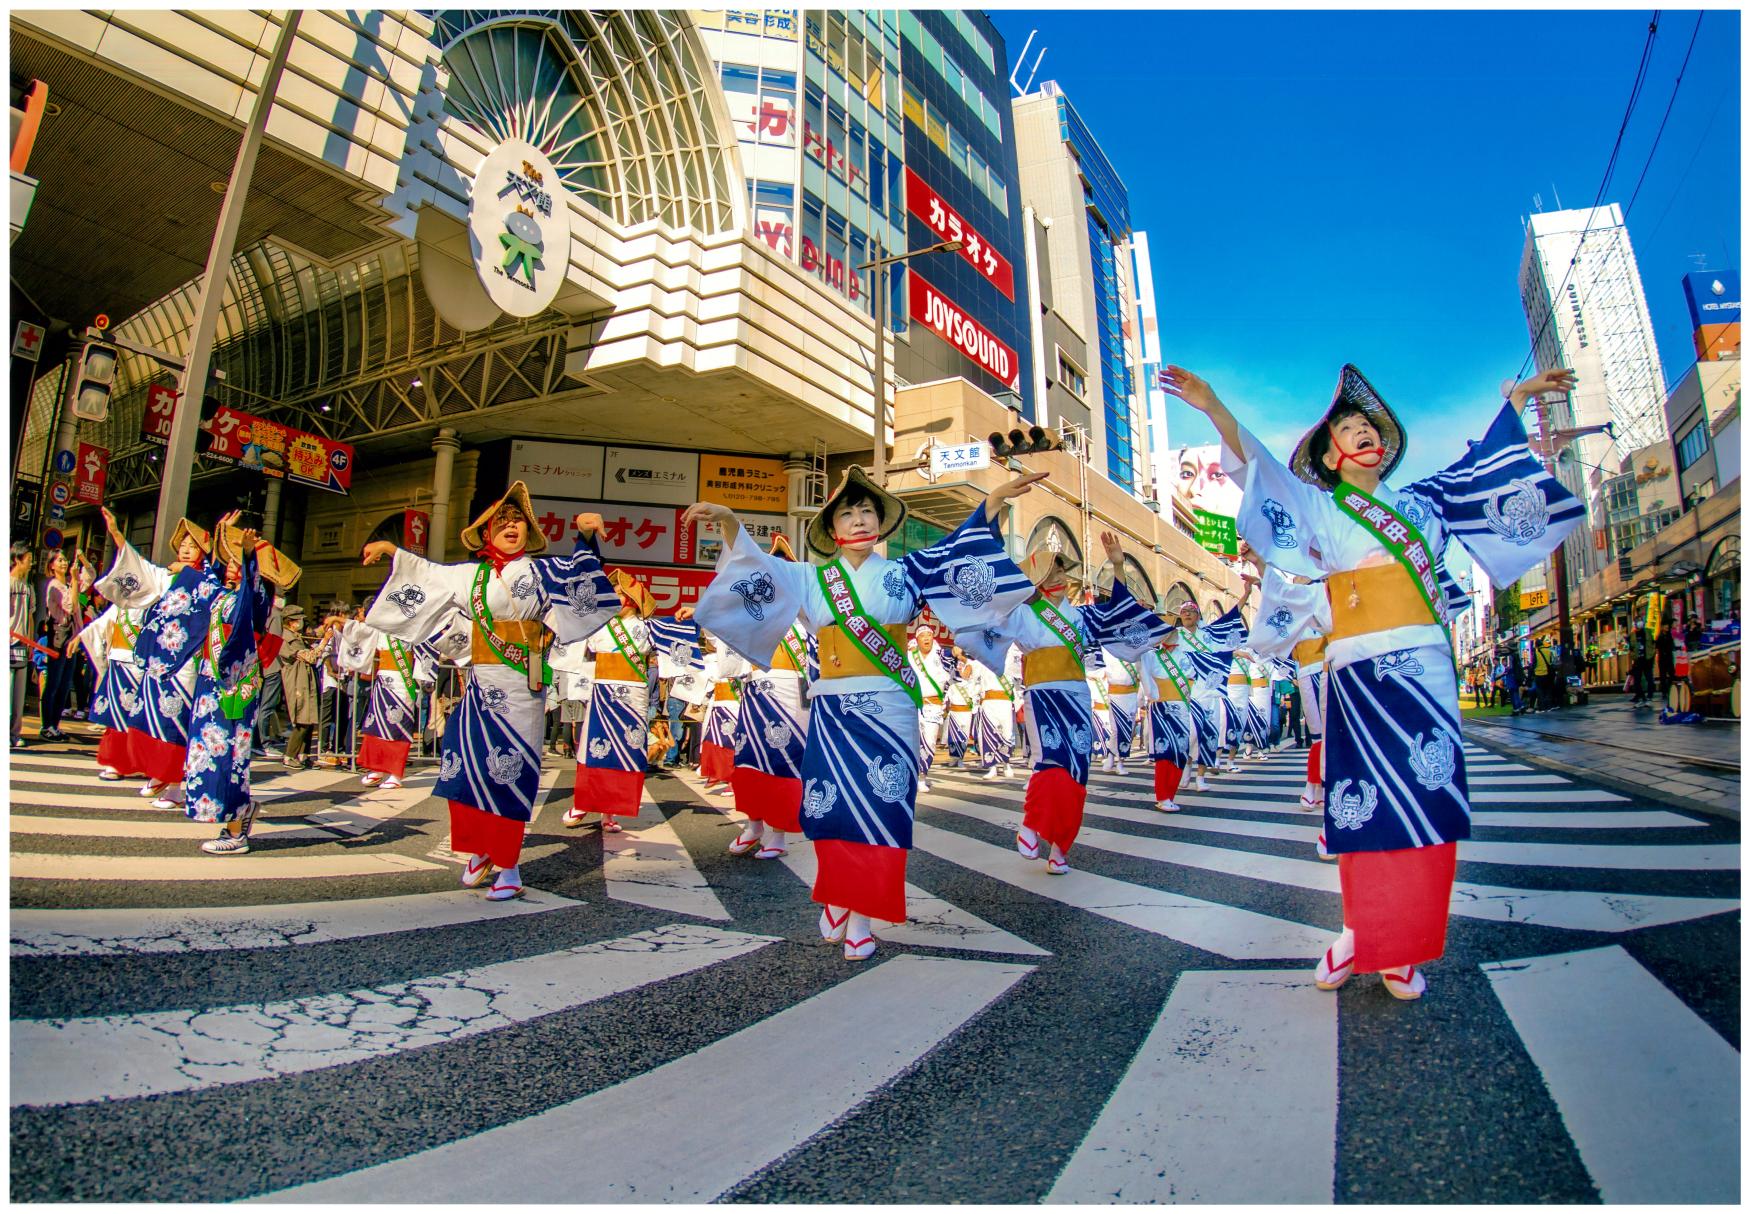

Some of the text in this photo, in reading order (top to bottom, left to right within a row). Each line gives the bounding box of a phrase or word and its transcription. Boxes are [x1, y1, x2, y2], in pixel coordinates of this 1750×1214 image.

[521, 159, 544, 182] The
[497, 170, 552, 216] 天文館
[929, 198, 998, 276] カラオケ
[493, 265, 504, 277] The
[924, 290, 1009, 379] JOYSOUND
[294, 448, 324, 464] 持込み
[332, 454, 347, 467] 4F
[940, 447, 980, 462] 天文館
[301, 465, 314, 475] OK
[944, 460, 978, 469] Tenmonkan
[822, 565, 916, 690] 関東甲南同窓会
